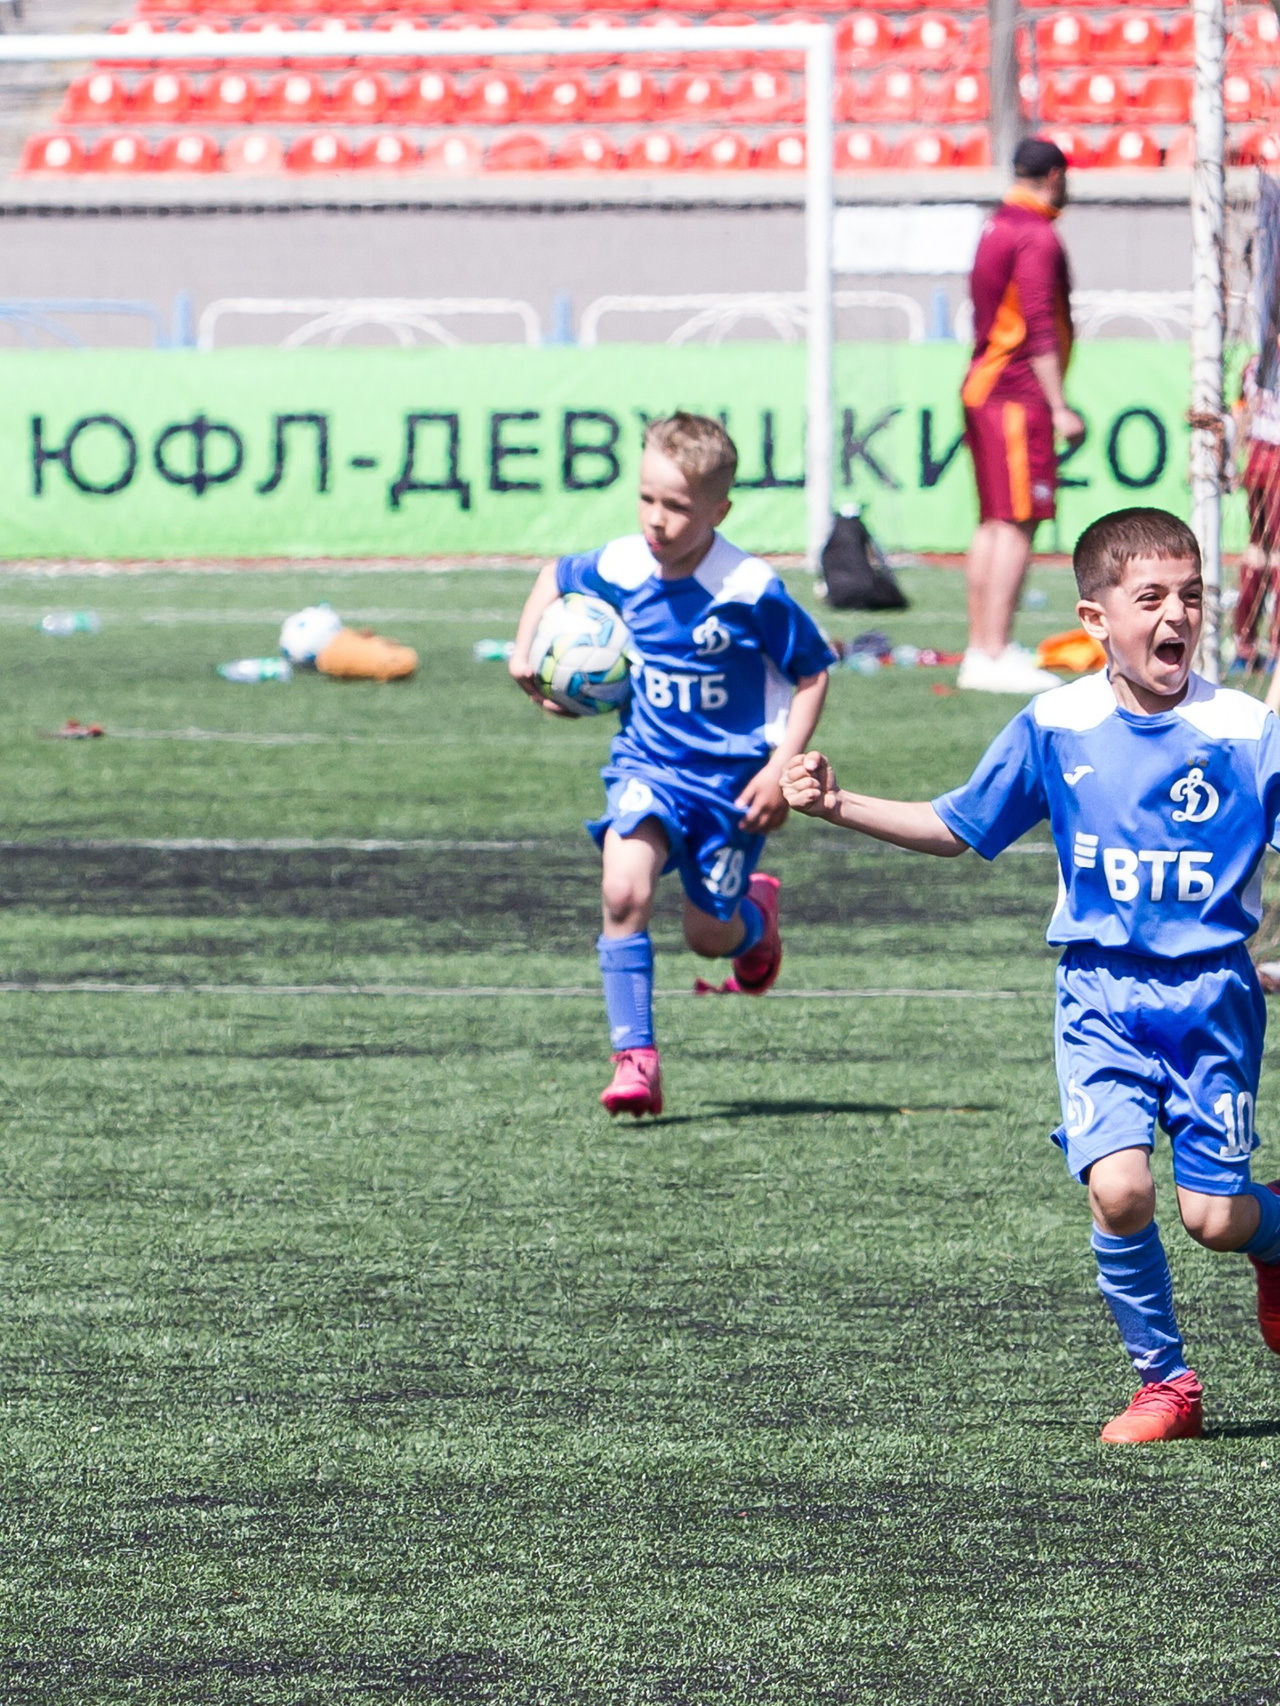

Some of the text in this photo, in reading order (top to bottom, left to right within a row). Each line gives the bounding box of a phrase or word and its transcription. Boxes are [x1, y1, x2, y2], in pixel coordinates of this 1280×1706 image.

[32, 411, 966, 510] ЮФЛ-ДЕВШКИ
[643, 665, 729, 713] ВТБ
[1102, 847, 1215, 902] ВТБ
[1214, 1091, 1254, 1157] 10
